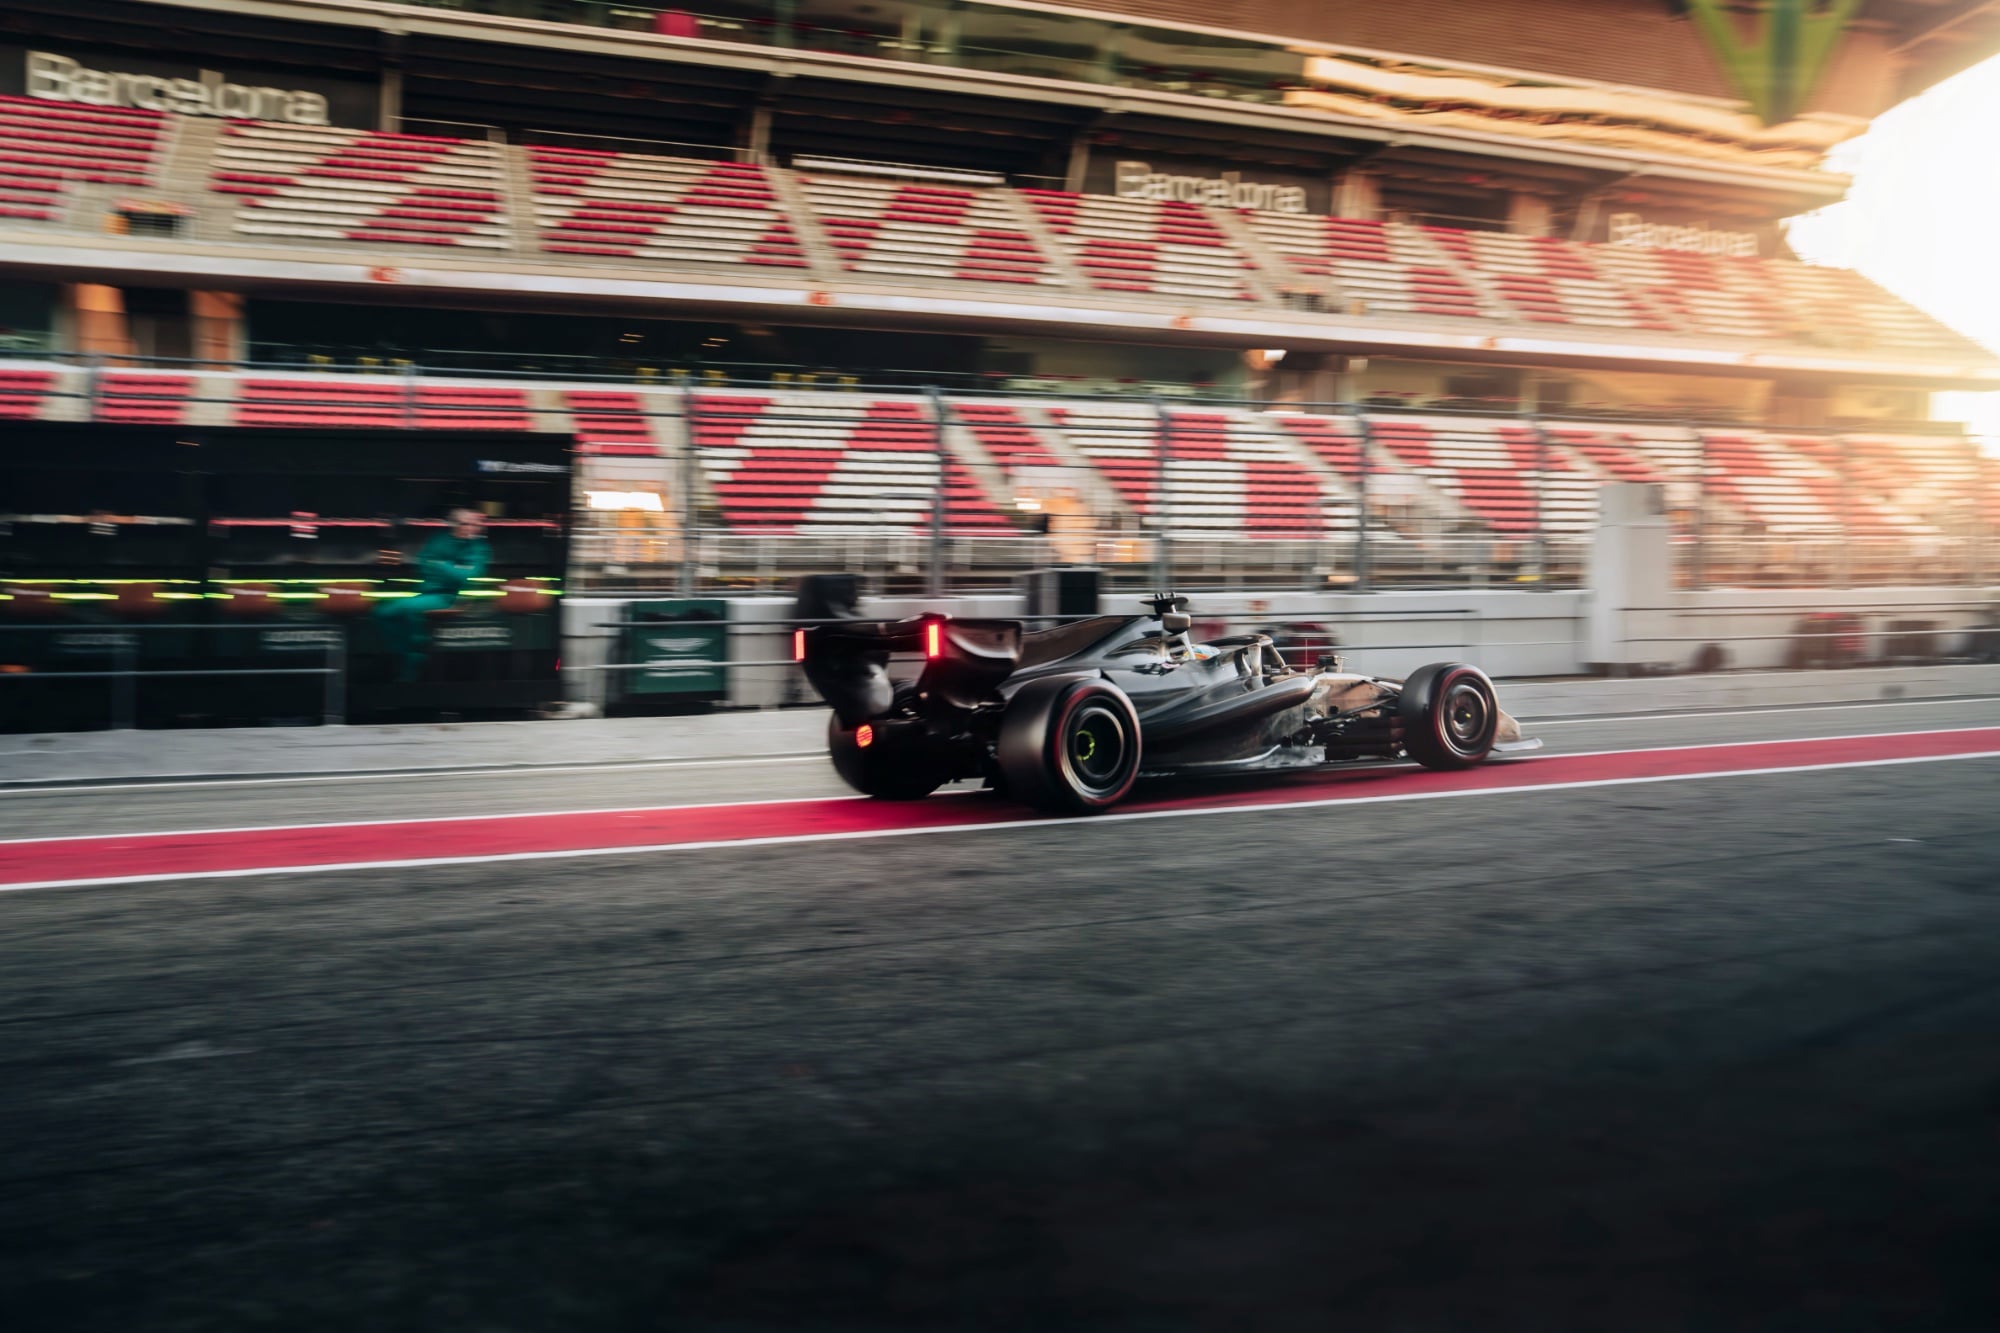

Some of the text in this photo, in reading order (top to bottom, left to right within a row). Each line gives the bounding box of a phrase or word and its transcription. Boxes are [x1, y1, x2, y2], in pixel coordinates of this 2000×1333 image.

[26, 51, 331, 125] Barcelona
[1115, 161, 1308, 213] Barcelona
[1609, 213, 1759, 256] Barcelona
